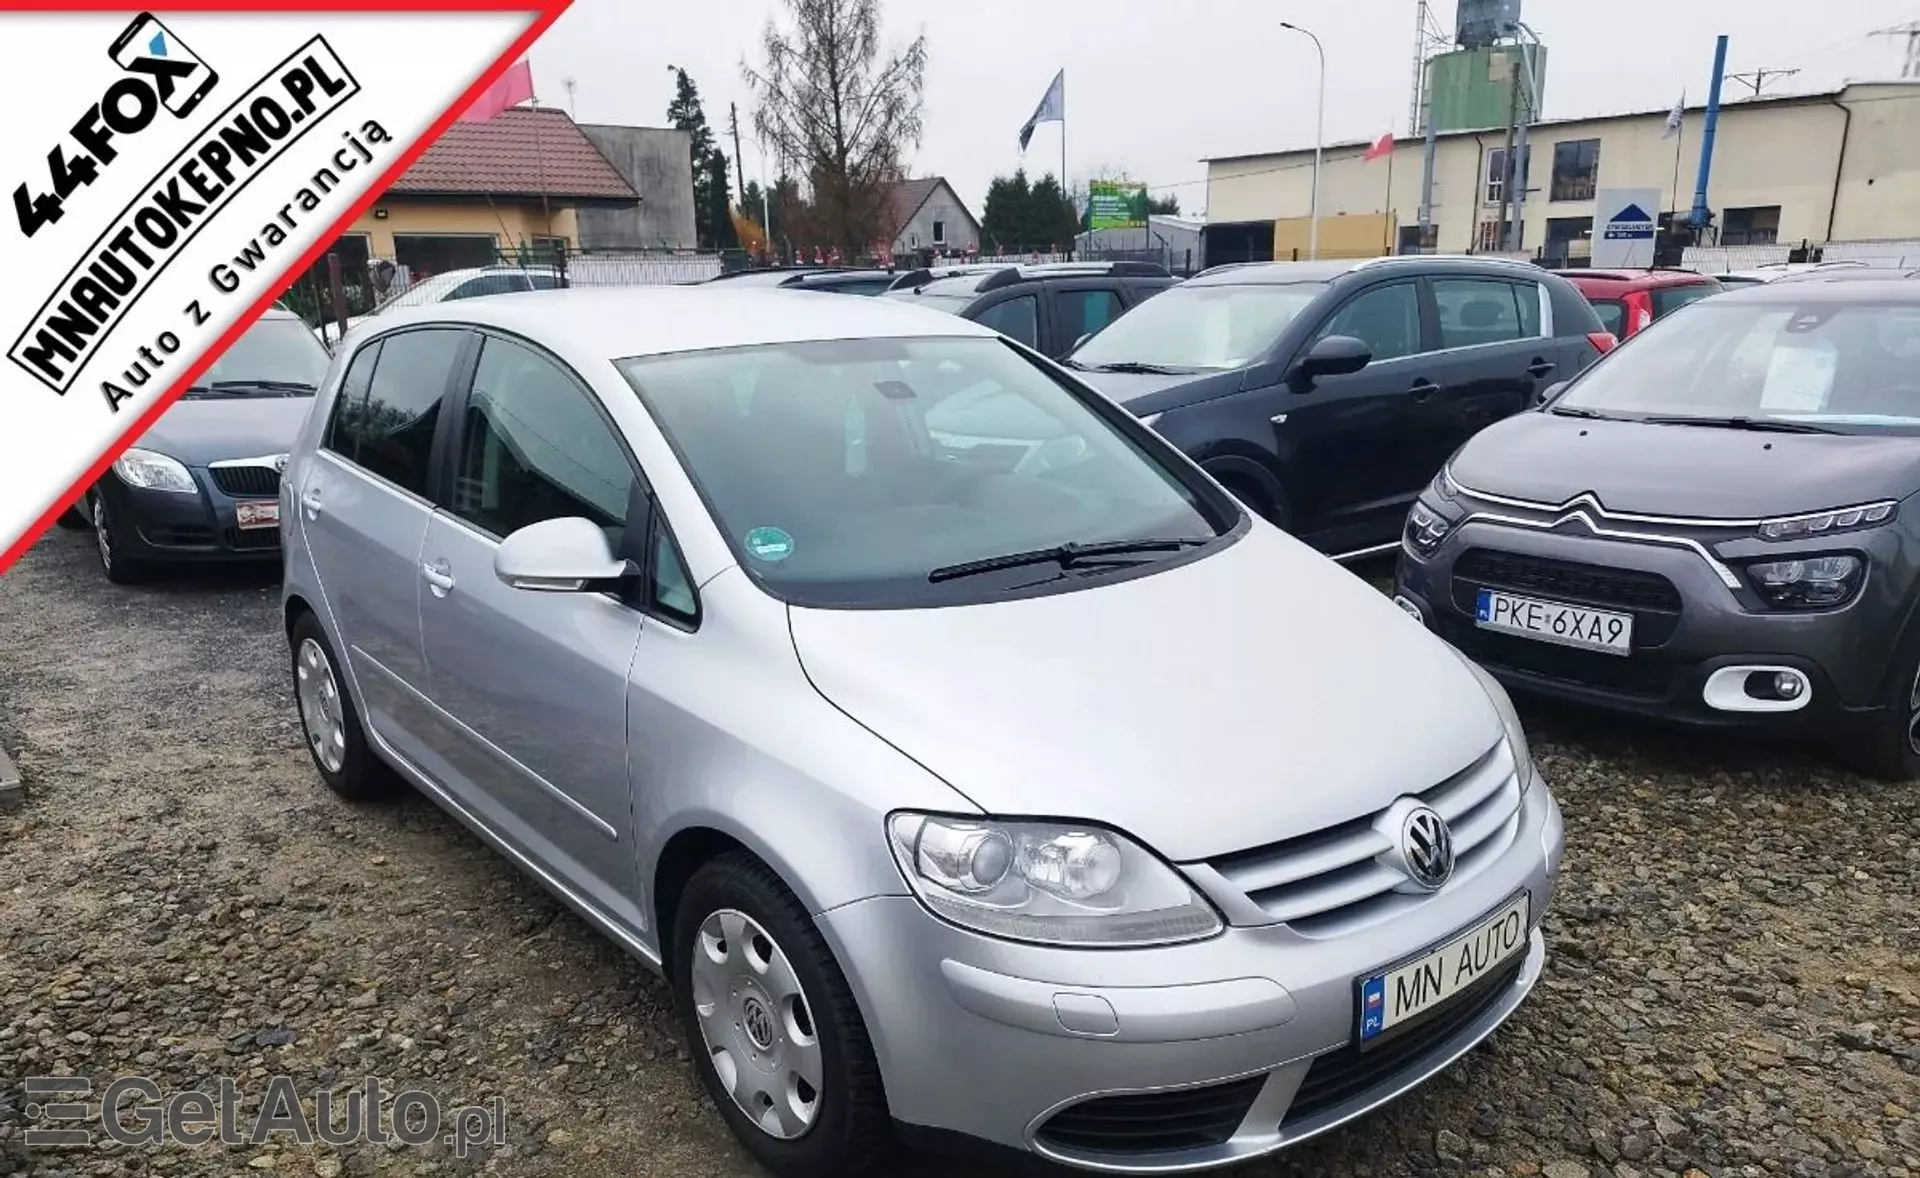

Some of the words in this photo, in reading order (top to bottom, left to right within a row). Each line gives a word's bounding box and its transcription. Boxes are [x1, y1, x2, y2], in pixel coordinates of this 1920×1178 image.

[1494, 597, 1544, 630] PKE
[1552, 609, 1623, 643] 6XA9
[1395, 957, 1443, 1017] MN
[1455, 910, 1520, 986] AUTO
[1366, 1016, 1381, 1031] PL
